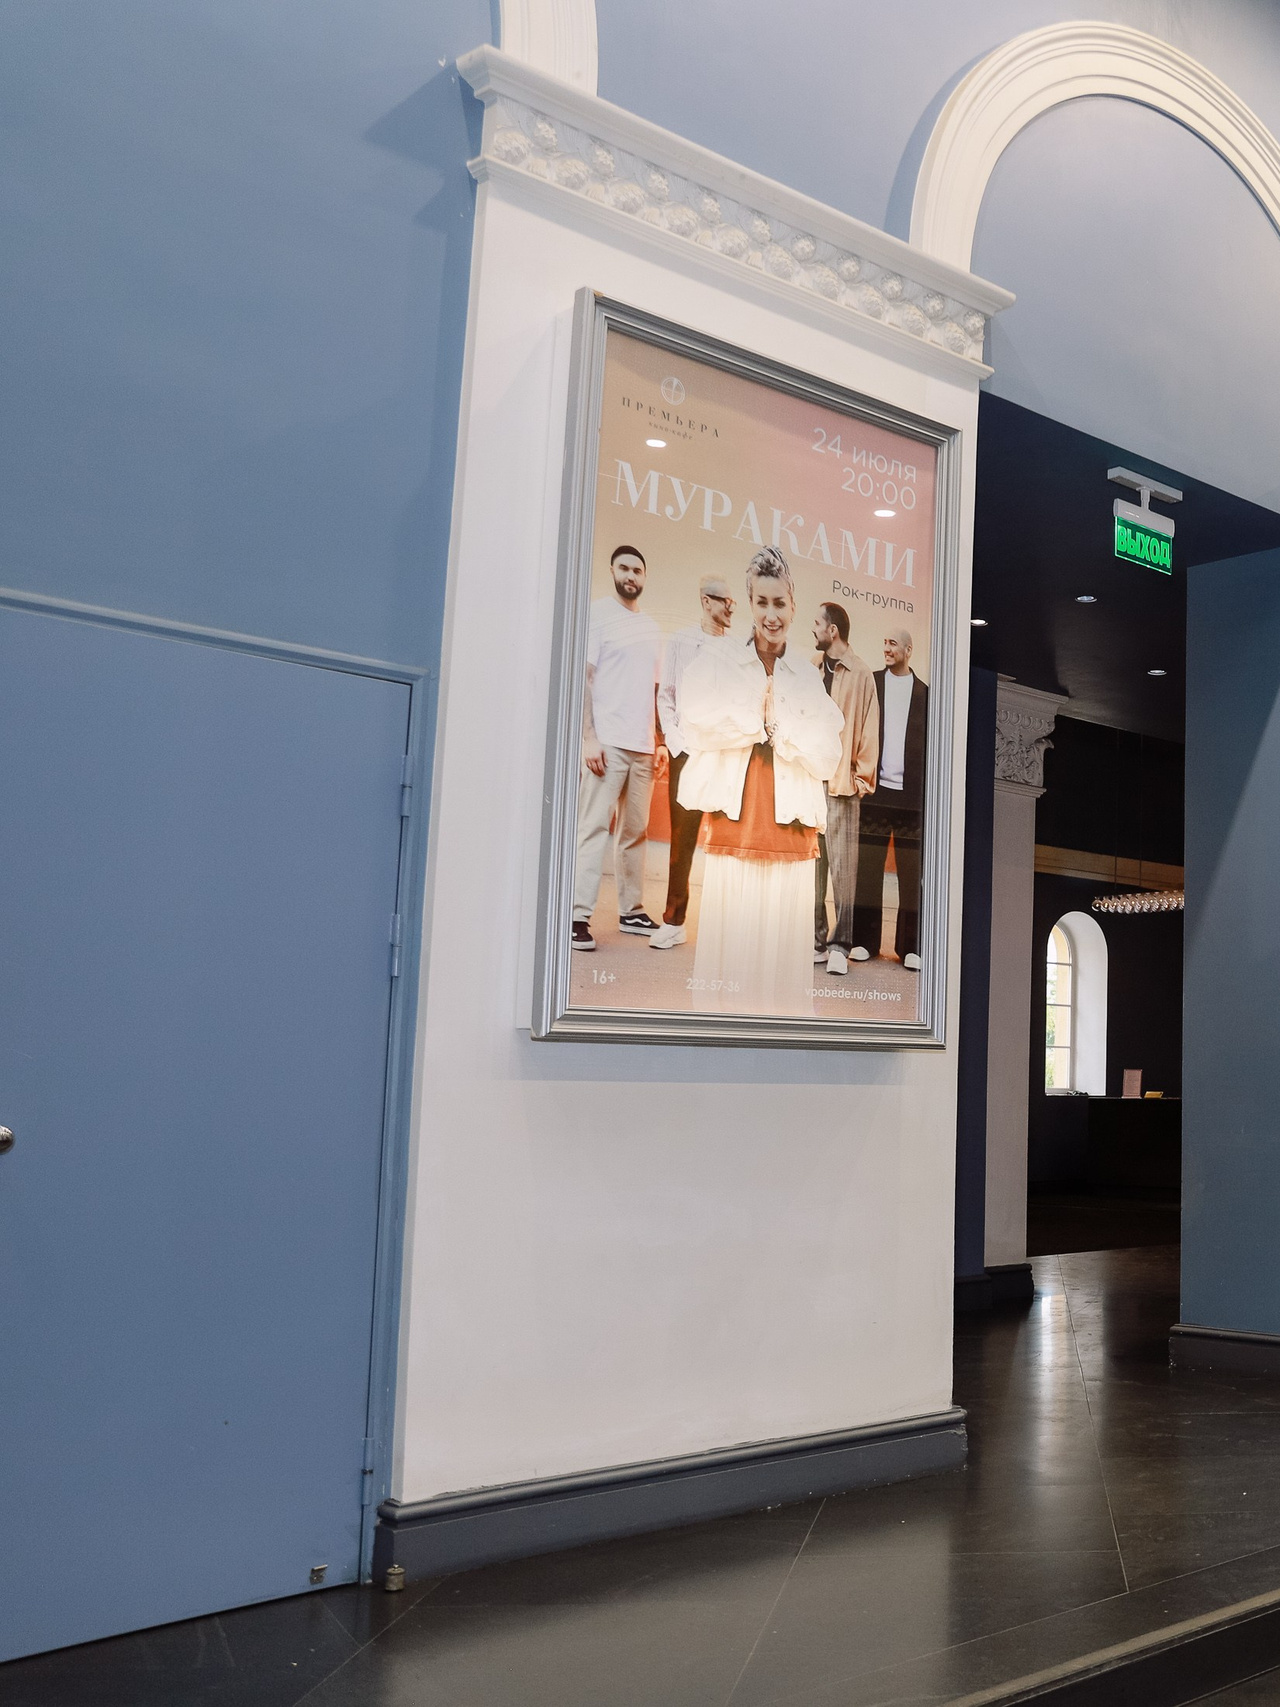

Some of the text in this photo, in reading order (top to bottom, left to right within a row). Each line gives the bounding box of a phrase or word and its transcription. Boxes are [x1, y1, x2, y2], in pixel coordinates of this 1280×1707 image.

[622, 396, 720, 438] ПРЕМЬЕРА
[811, 427, 917, 484] 24 июля
[841, 467, 917, 511] 20:00
[611, 459, 918, 589] МУРАКАМИ
[1117, 524, 1171, 569] ВЫХОД
[832, 579, 915, 614] Рок-группа
[593, 969, 902, 1002] 16+ 222-57-36 vpobede.ru/shows
